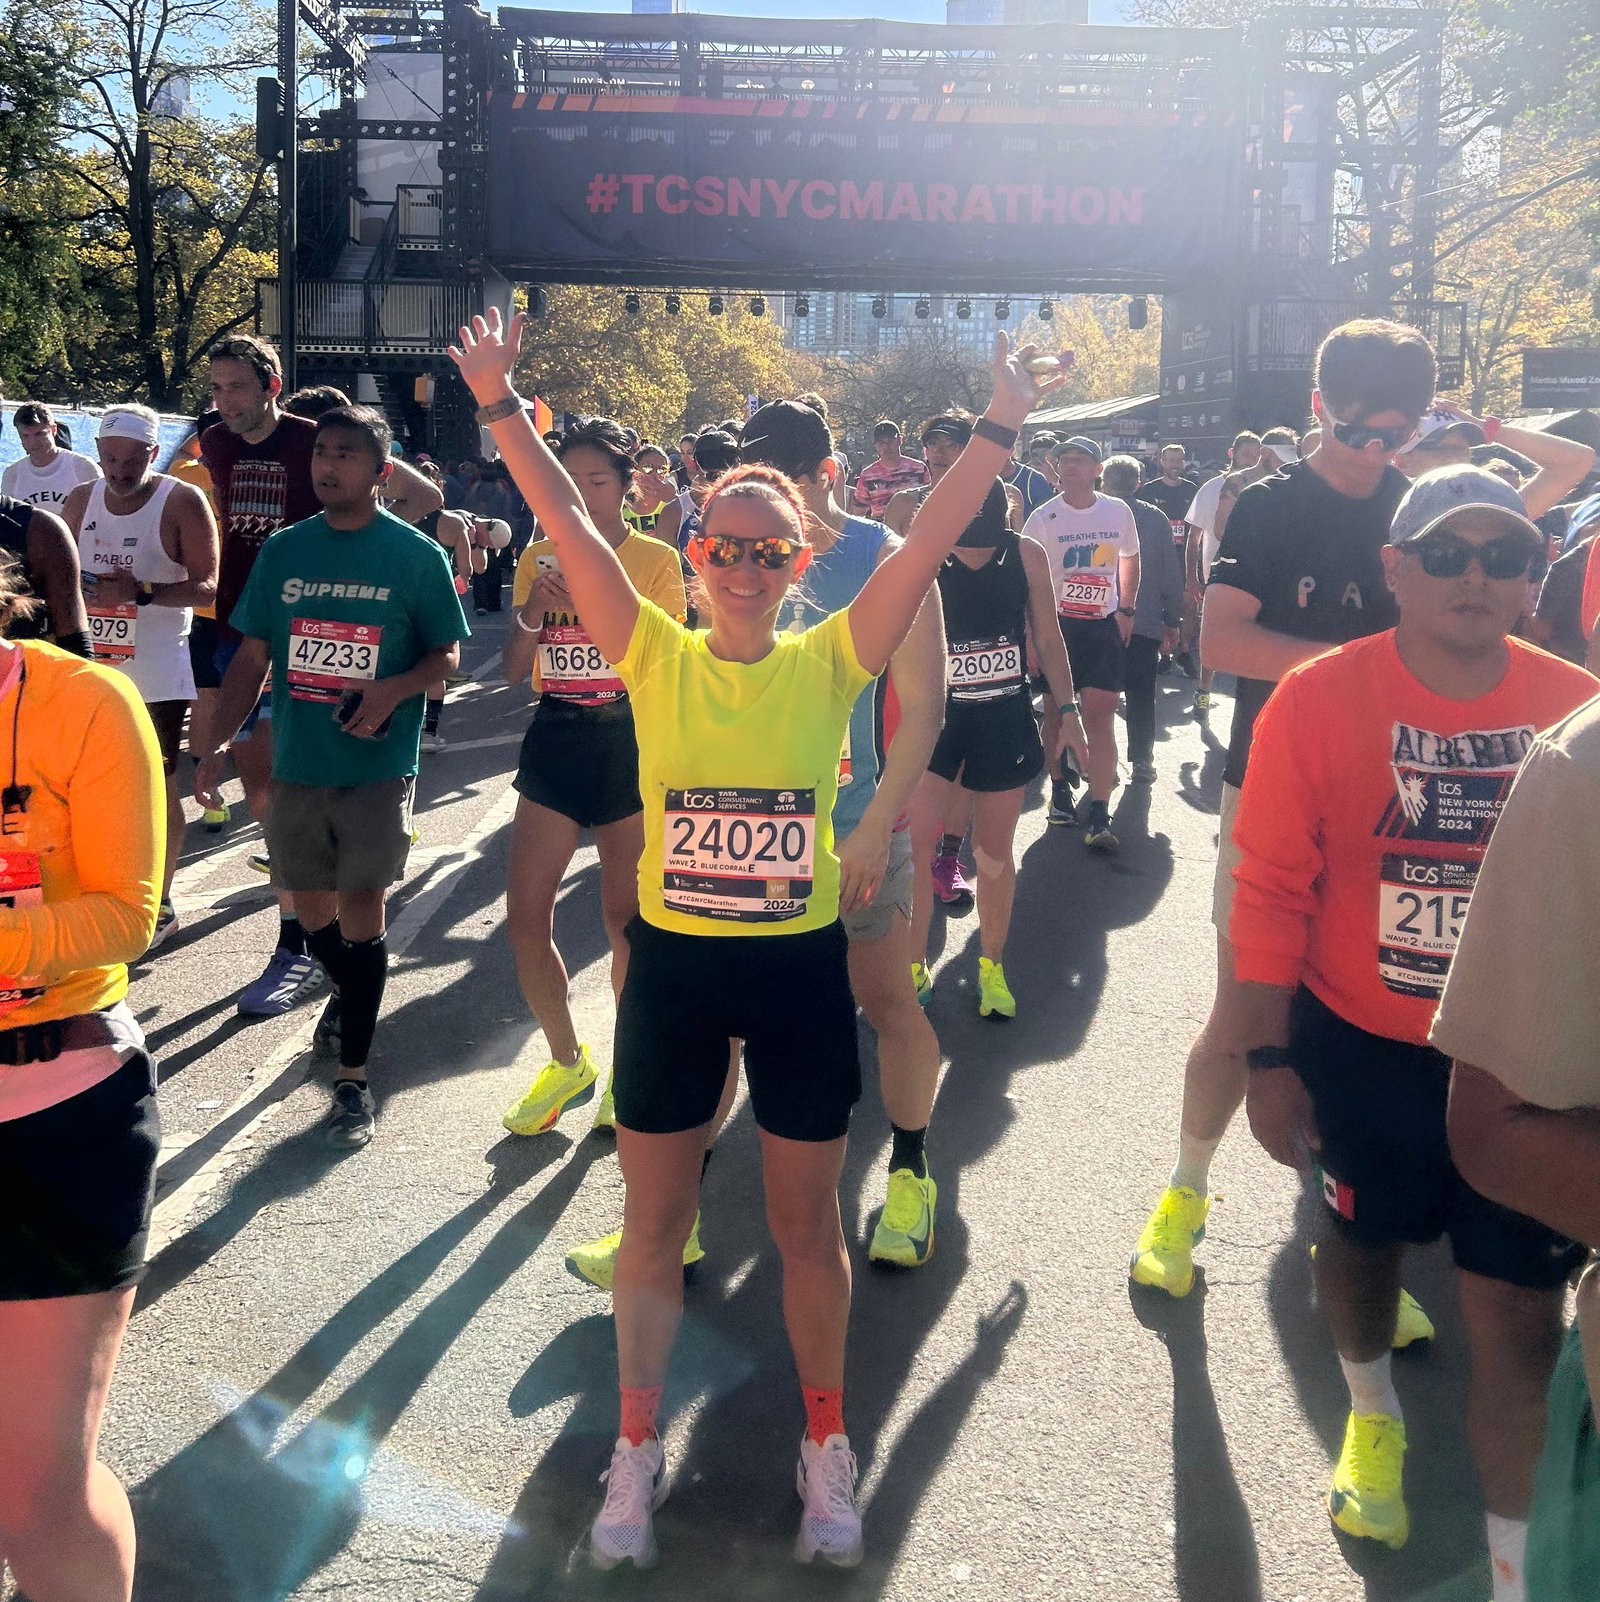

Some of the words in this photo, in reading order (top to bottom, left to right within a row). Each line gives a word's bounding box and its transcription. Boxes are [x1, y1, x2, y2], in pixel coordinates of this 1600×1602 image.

[586, 173, 1144, 226] #TCSNYCMARATHON
[1058, 533, 1097, 543] BREATHE
[1099, 531, 1119, 539] TEAM
[94, 554, 134, 565] PABLO
[281, 578, 391, 604] SUPREME
[1066, 584, 1107, 601] 22871
[301, 620, 320, 635] tcs
[295, 639, 372, 671] 47233
[952, 642, 970, 653] tcs
[546, 646, 610, 671] 1668
[951, 649, 1016, 678] 26028
[596, 691, 617, 699] 2024
[1393, 724, 1534, 769] ALBERTO
[1437, 780, 1462, 796] tcs
[683, 790, 715, 809] tcs
[1438, 797, 1463, 807] NEW
[1464, 799, 1493, 809] YORK
[774, 804, 797, 812] TATA
[1438, 807, 1498, 819] MARATHON
[1438, 818, 1473, 830] 2024
[672, 816, 806, 863] 24020
[668, 859, 689, 867] WAVE
[689, 859, 697, 869] 2
[700, 862, 718, 870] BLUE
[719, 864, 747, 873] CORRAL
[748, 863, 756, 873] E
[1403, 860, 1439, 884] tcs
[1443, 864, 1466, 872] TATA
[770, 884, 785, 893] VIP
[678, 895, 738, 907] #TCSNYCMarathon
[763, 899, 795, 911] 2024
[1395, 891, 1471, 938] 215
[1385, 933, 1408, 944] WAVE
[1410, 937, 1418, 947] 2
[1423, 941, 1443, 949] BLUE
